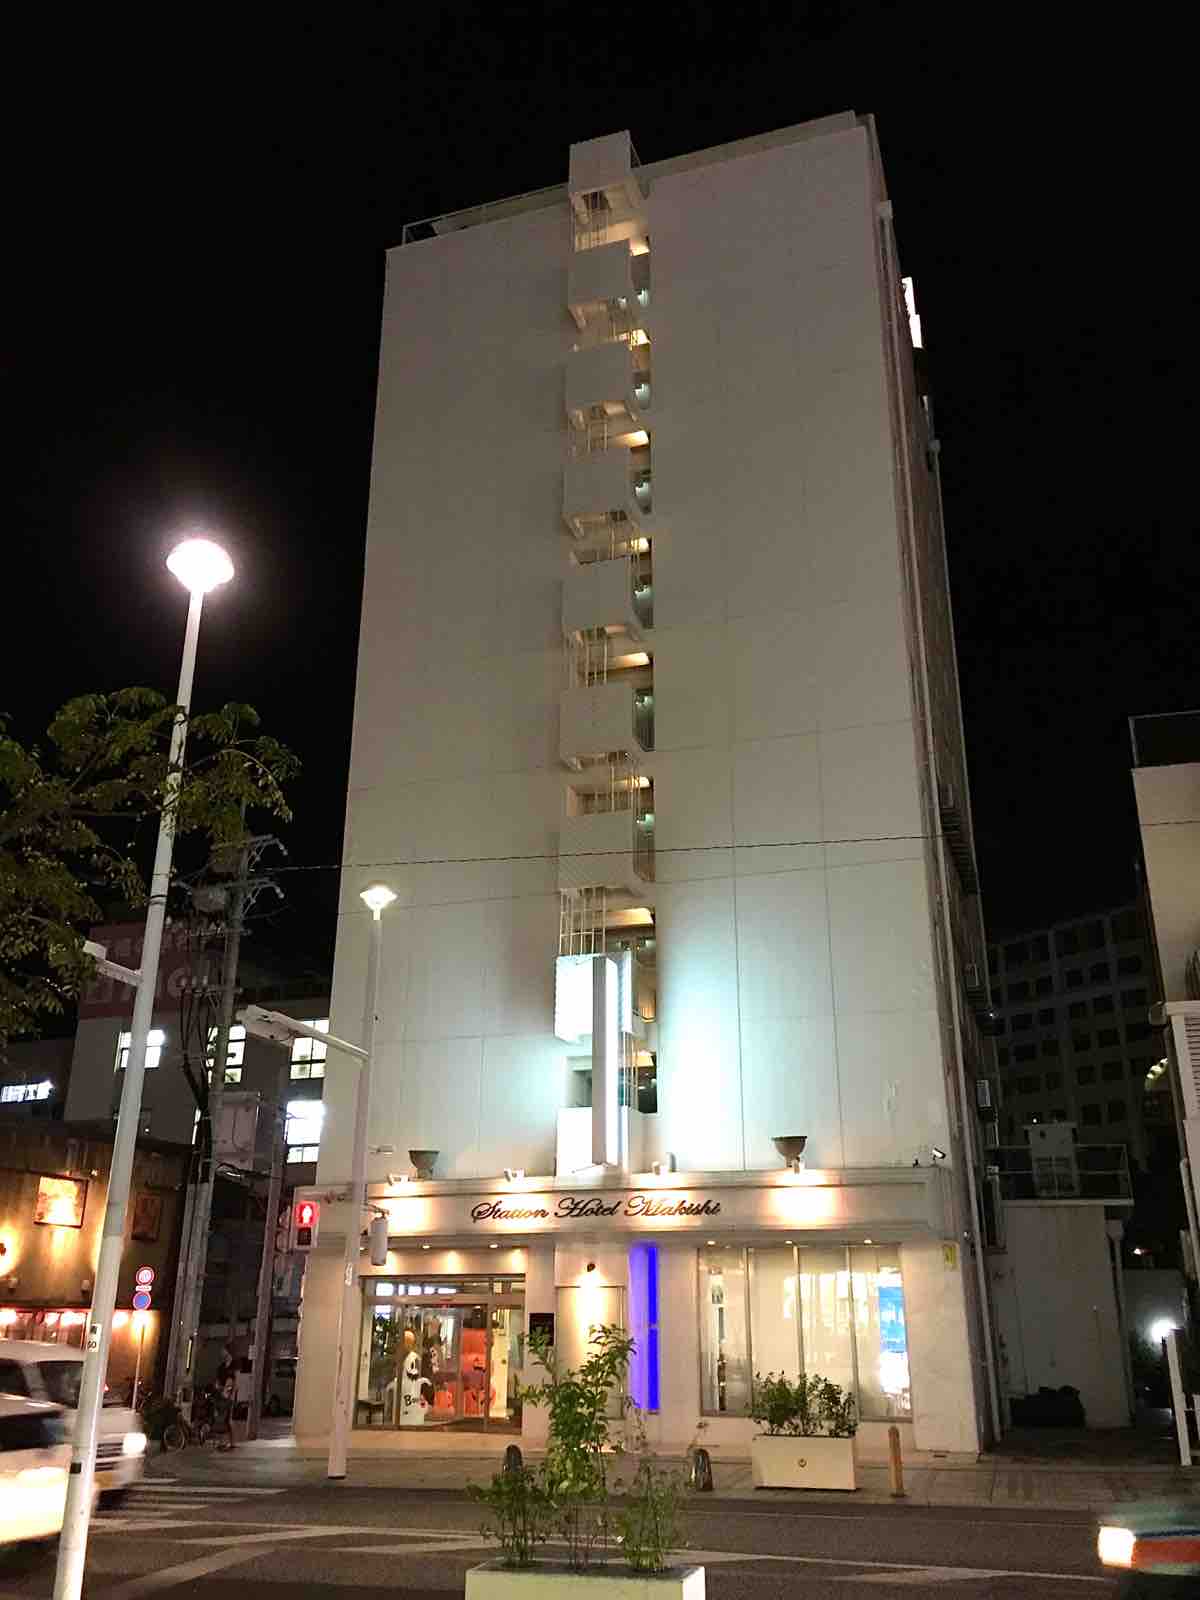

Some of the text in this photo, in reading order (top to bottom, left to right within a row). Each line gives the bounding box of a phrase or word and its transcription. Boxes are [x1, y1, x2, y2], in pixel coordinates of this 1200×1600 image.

[471, 1195, 722, 1223] Station Hotel Makishi
